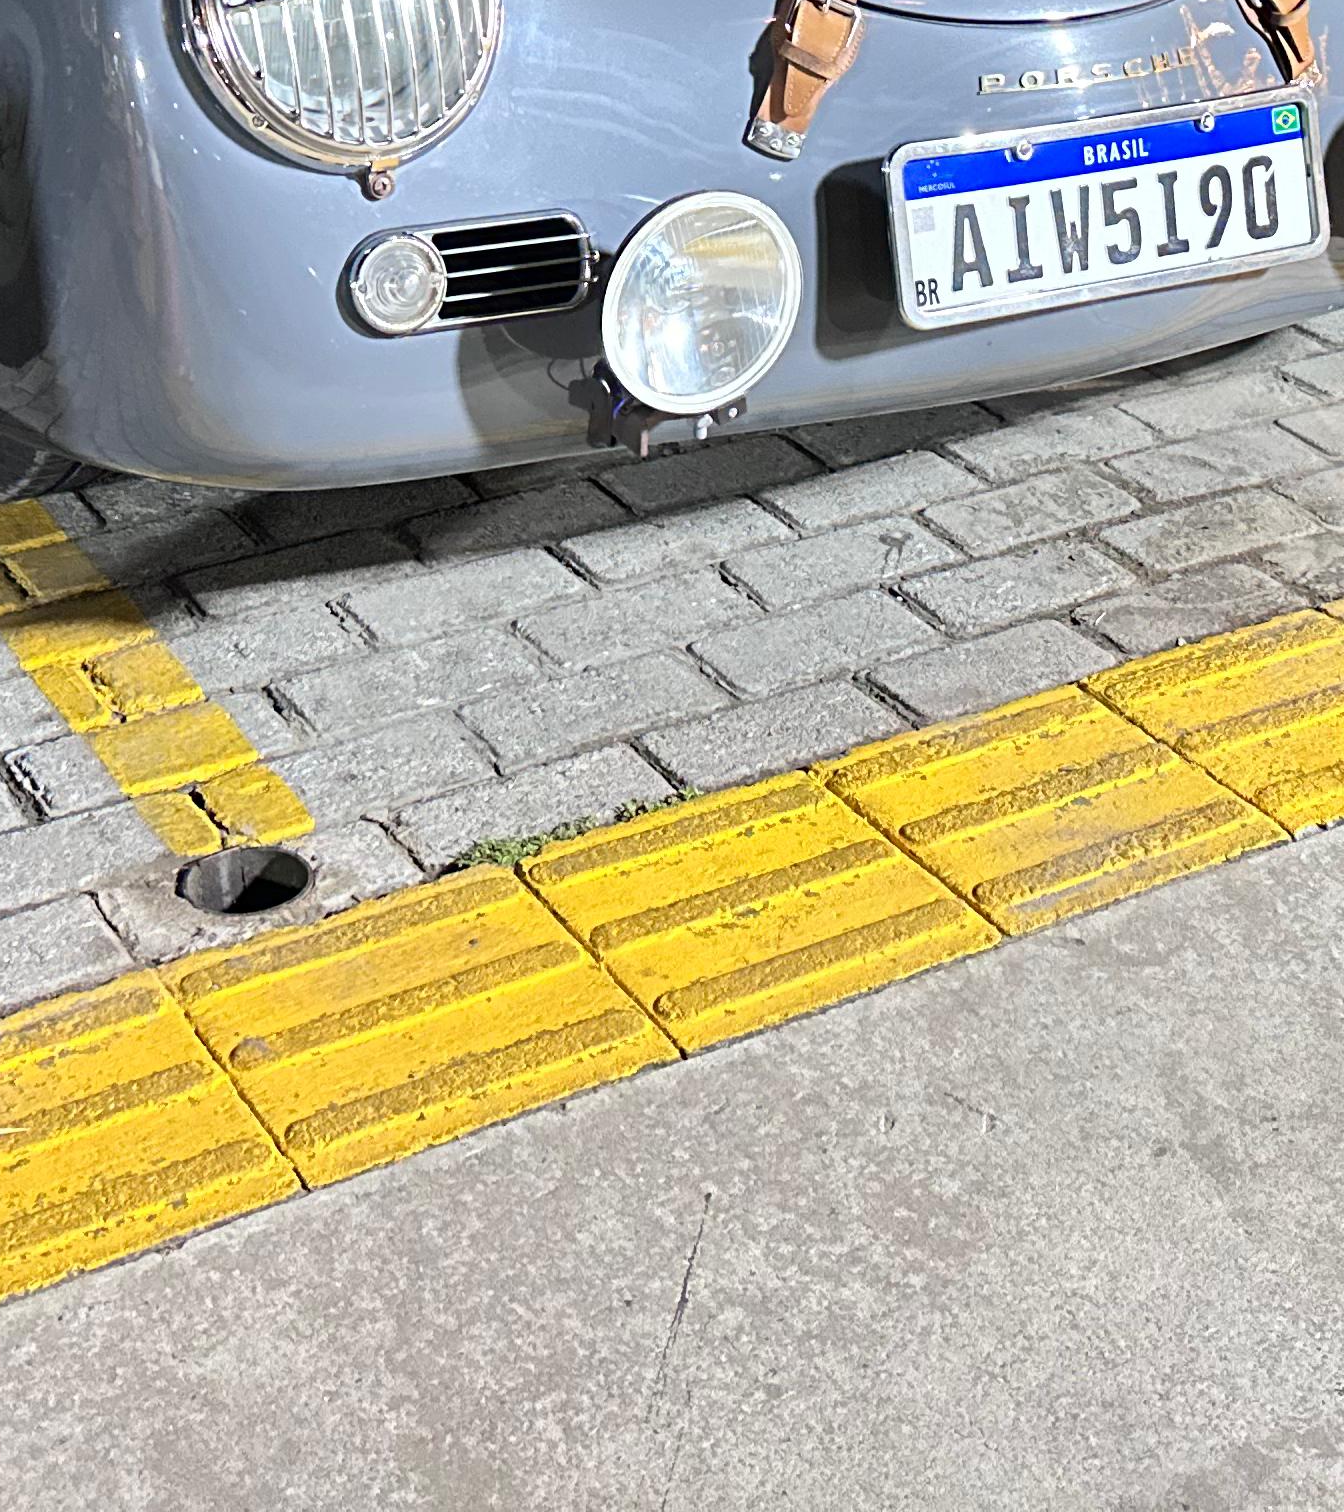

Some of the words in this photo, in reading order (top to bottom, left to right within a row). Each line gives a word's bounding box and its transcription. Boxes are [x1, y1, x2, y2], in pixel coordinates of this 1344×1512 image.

[978, 46, 1197, 94] PORSCHE
[1083, 137, 1149, 166] BRASIL
[918, 181, 956, 193] MERCOSUL
[952, 155, 1279, 292] AIW5I90
[914, 278, 941, 307] BR
